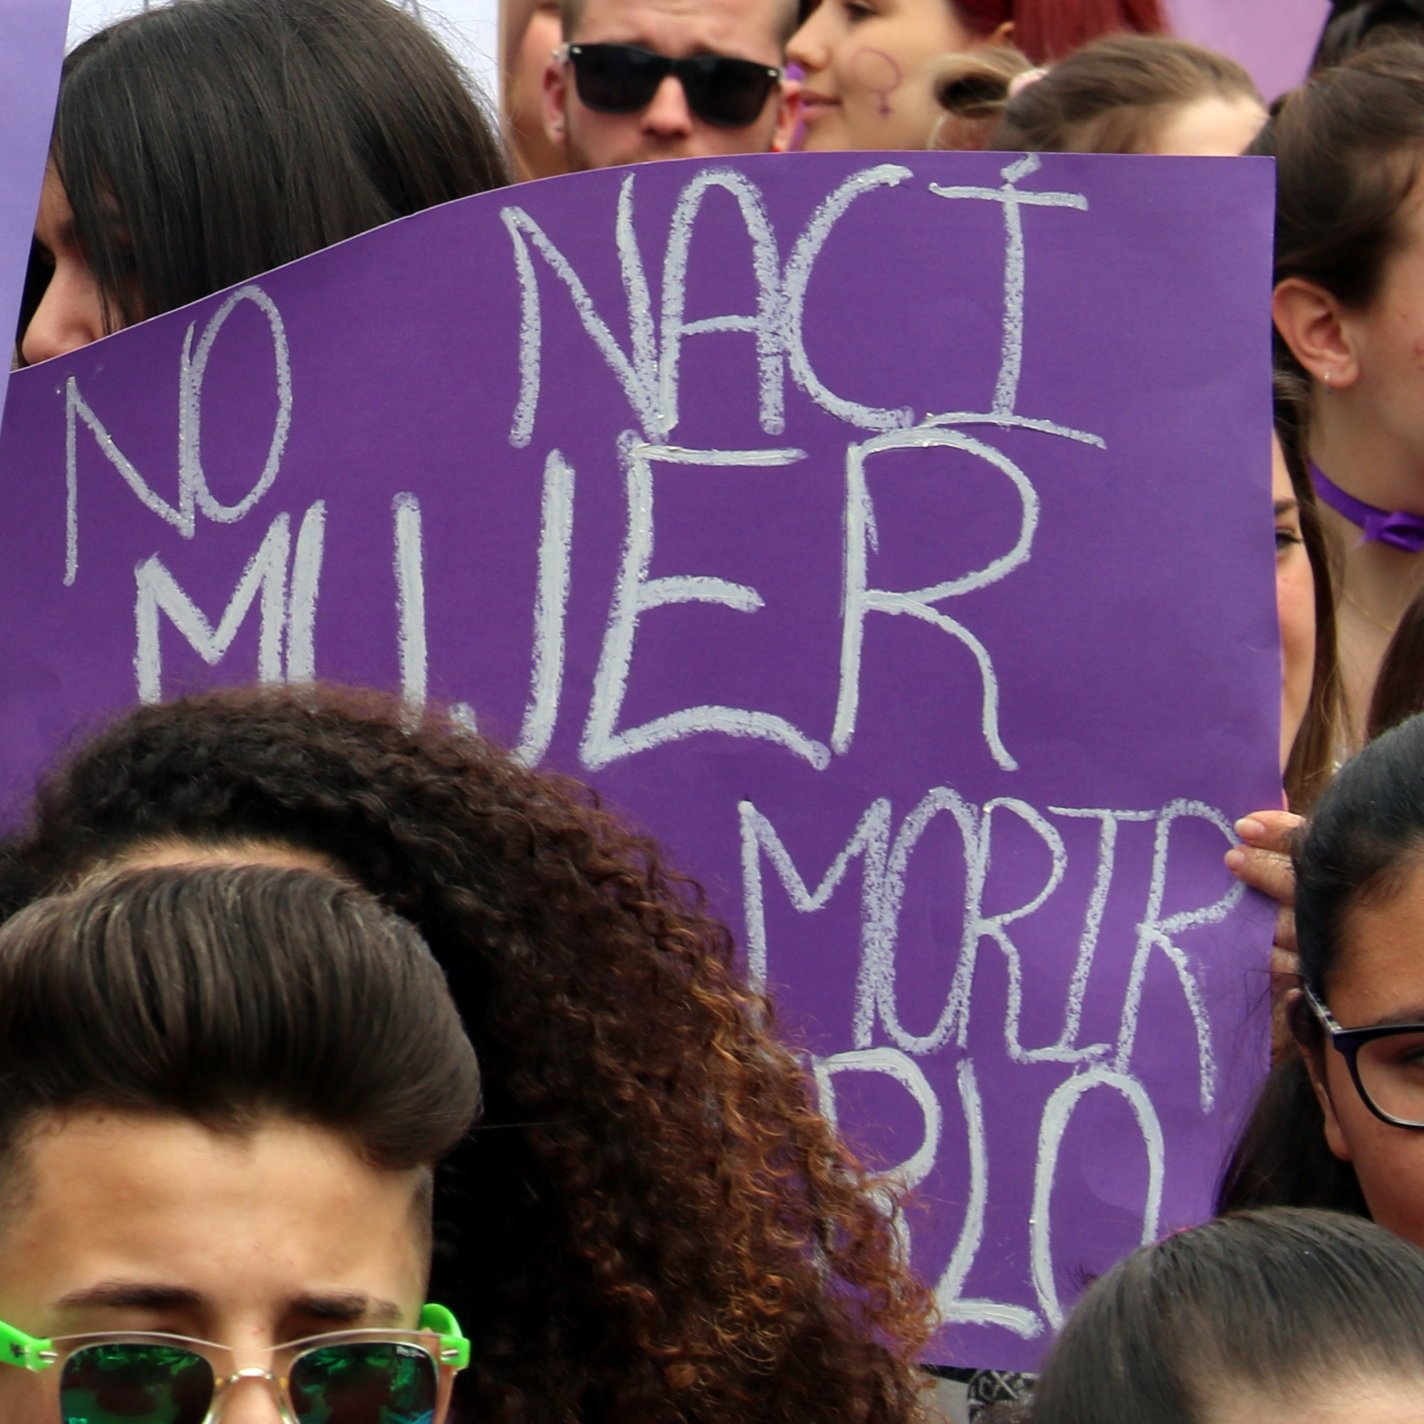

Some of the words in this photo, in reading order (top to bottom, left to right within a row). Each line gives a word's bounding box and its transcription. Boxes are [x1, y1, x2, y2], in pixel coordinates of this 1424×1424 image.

[61, 282, 294, 589] NO
[500, 151, 1108, 450] NACÍ
[735, 785, 1258, 1114] MORIR
